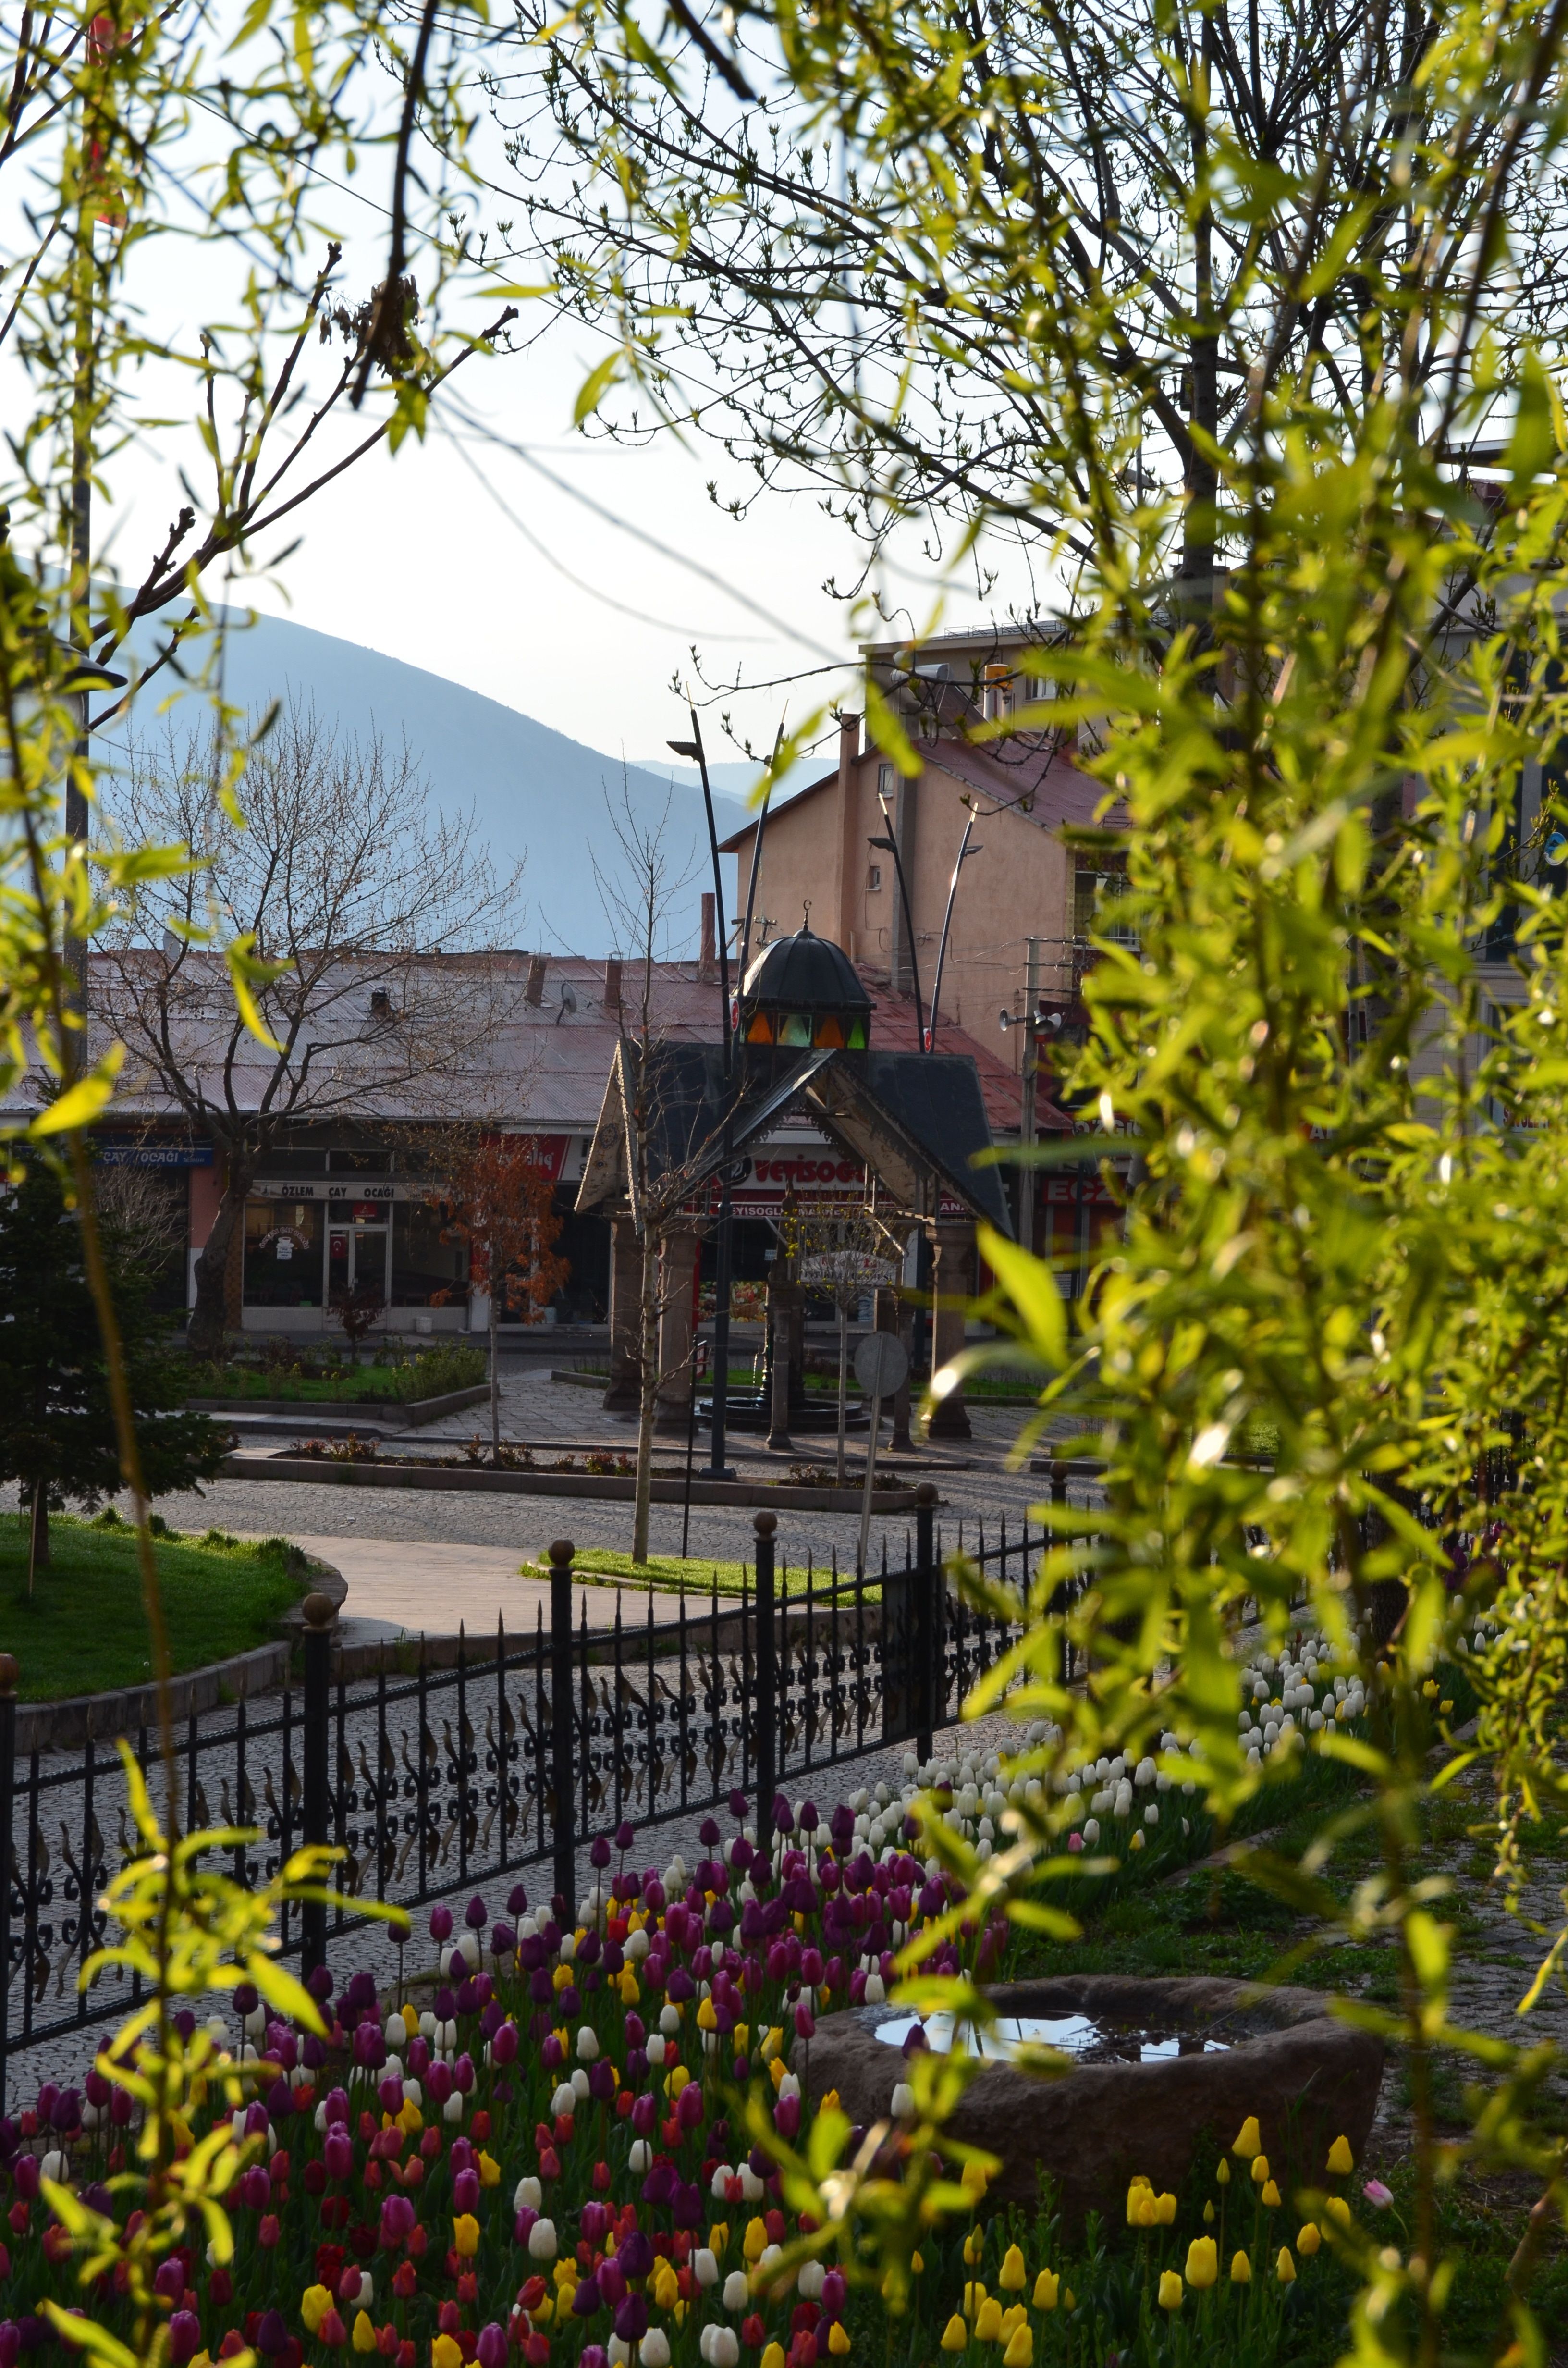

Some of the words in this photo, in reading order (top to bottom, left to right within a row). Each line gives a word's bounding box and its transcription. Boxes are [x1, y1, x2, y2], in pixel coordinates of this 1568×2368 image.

[103, 1152, 126, 1164] ÇAY
[140, 1150, 179, 1162] OCAĞI
[282, 1184, 313, 1196] ÖZLEM
[329, 1187, 347, 1199] ÇAY
[364, 1186, 394, 1198] OCAĞI
